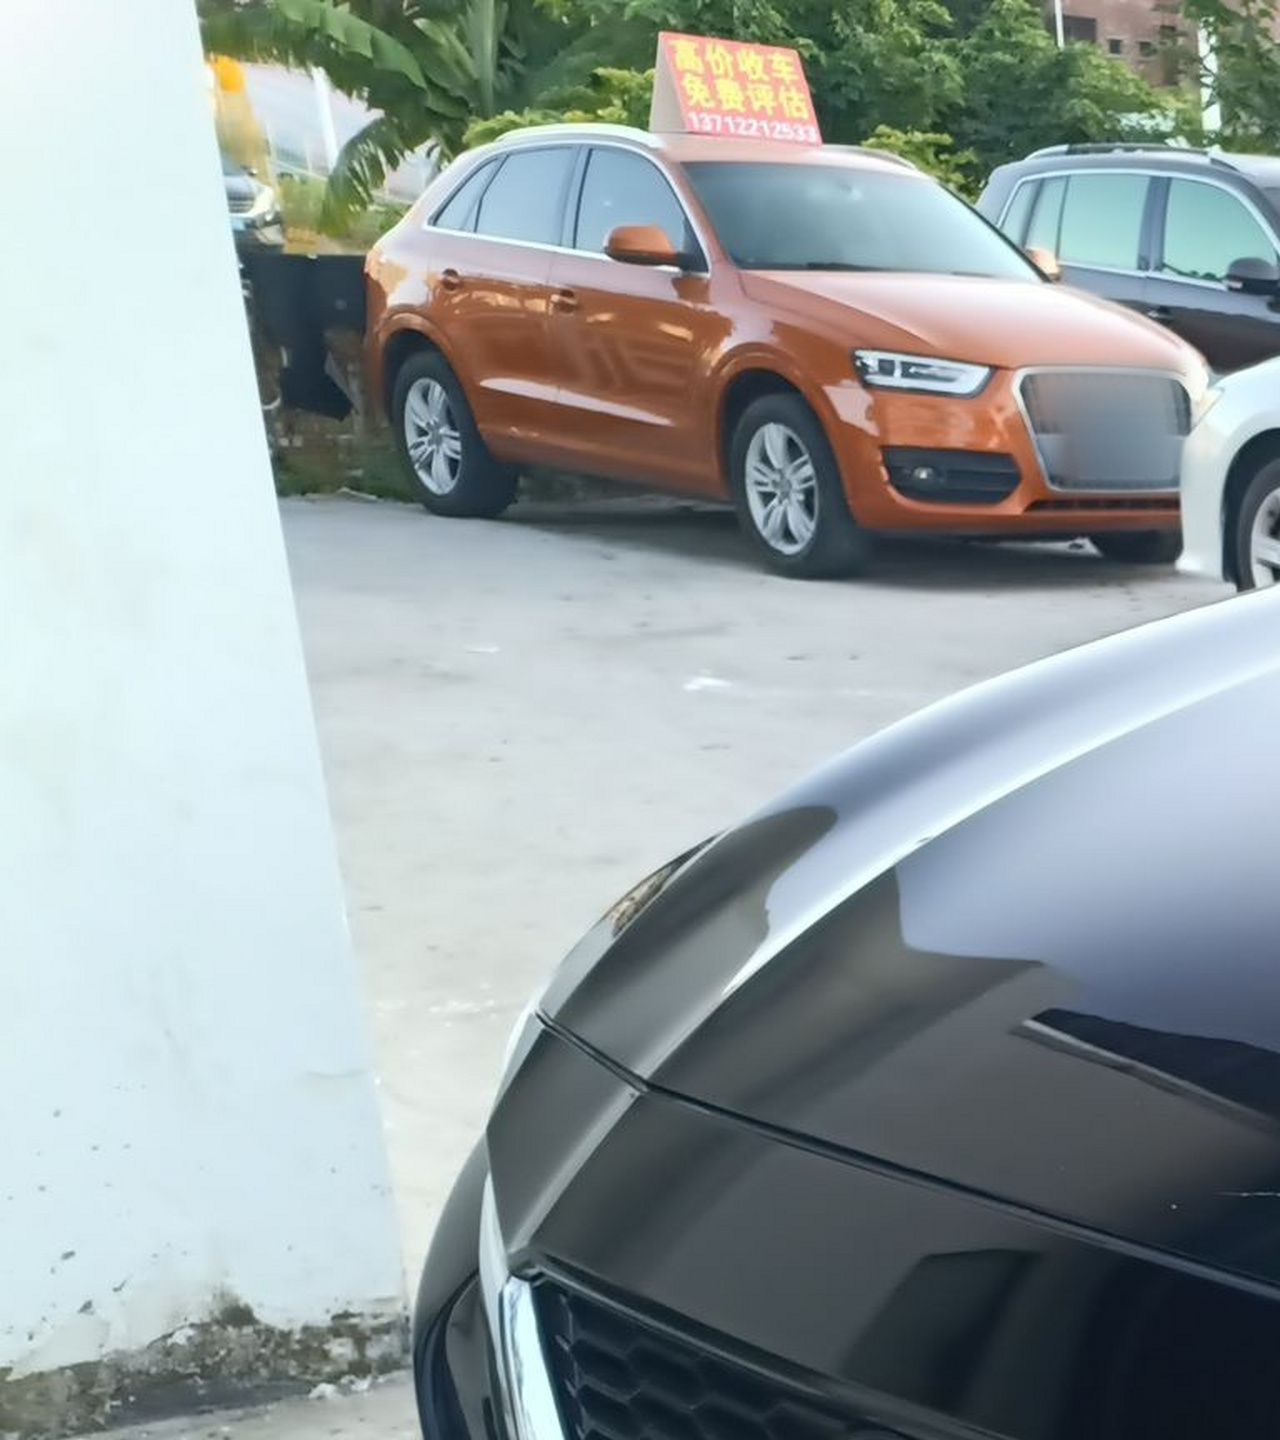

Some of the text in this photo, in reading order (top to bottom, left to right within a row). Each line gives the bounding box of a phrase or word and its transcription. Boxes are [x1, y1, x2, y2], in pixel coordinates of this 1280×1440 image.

[668, 39, 799, 84] 高价收车
[681, 72, 810, 120] 免费评估
